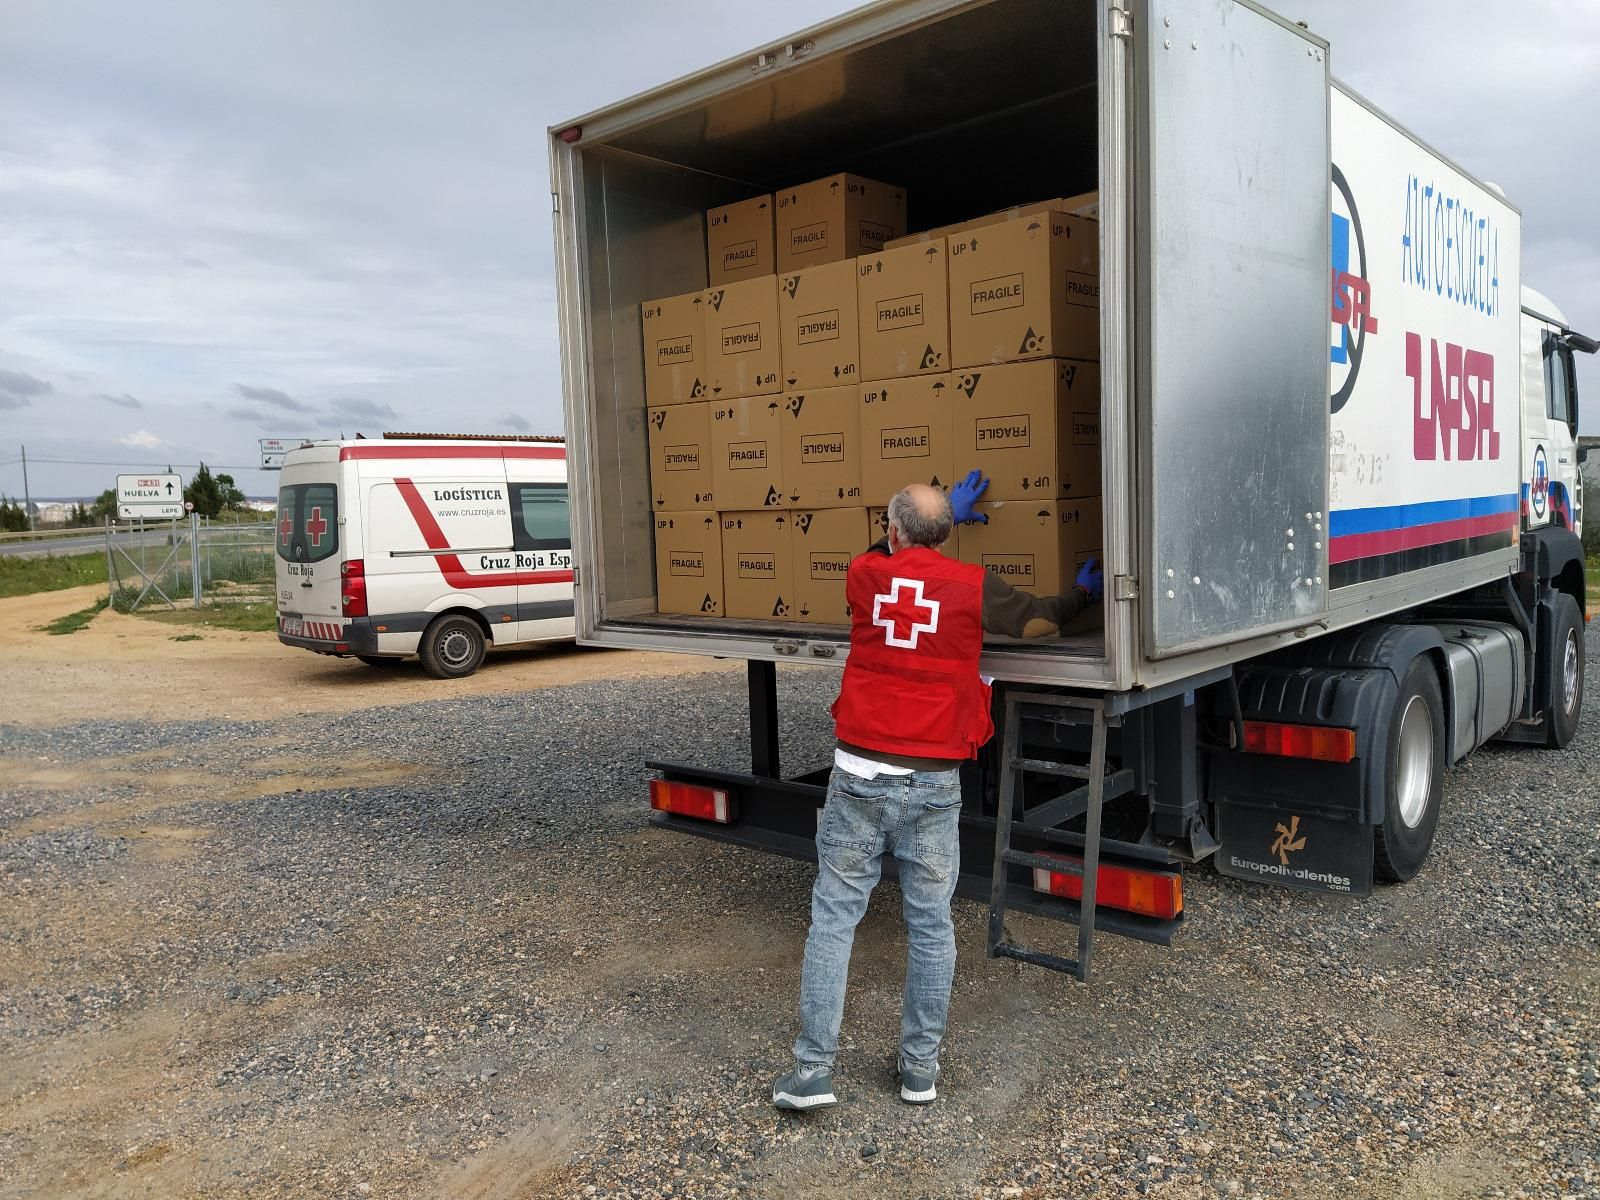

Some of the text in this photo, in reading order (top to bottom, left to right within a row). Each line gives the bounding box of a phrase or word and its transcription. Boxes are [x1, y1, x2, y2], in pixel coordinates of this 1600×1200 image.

[847, 184, 858, 194] UP
[779, 196, 789, 208] UP
[711, 215, 721, 226] UP
[1053, 225, 1063, 236] UP
[793, 230, 826, 245] FRAGILE
[952, 243, 967, 256] UP
[1402, 173, 1499, 317] AUTOESCUELA
[725, 247, 756, 263] FRAGILE
[861, 264, 873, 275] UP
[973, 284, 1021, 303] FRAGILE
[1332, 268, 1377, 335] SA
[644, 309, 654, 318] UP
[879, 303, 921, 320] FRAGILE
[800, 319, 837, 336] FRAGILE
[724, 331, 759, 346] FRAGILE
[659, 344, 690, 358] FRAGILE
[843, 364, 855, 374] UP
[765, 374, 775, 383] UP
[864, 392, 877, 403] UP
[715, 409, 725, 420] UP
[979, 426, 1027, 439] FRAGILE
[883, 435, 927, 449] FRAGILE
[804, 443, 842, 455] FRAGILE
[666, 453, 698, 462] FRAGILE
[731, 450, 765, 460] FRAGILE
[1035, 476, 1049, 487] UP
[433, 487, 502, 501] LOGÍSTICA
[703, 493, 712, 501] UP
[848, 487, 859, 496] UP
[437, 508, 506, 517] www.cruzroja.es
[1062, 512, 1071, 523] UP
[658, 520, 667, 528] UP
[725, 519, 734, 529] UP
[481, 555, 510, 569] Cruz
[516, 554, 544, 568] Roja
[672, 558, 702, 568] FRAGILE
[740, 559, 773, 570] FRAGILE
[288, 564, 313, 579] Cruz Roja
[1231, 856, 1351, 885] Europolivalentes
